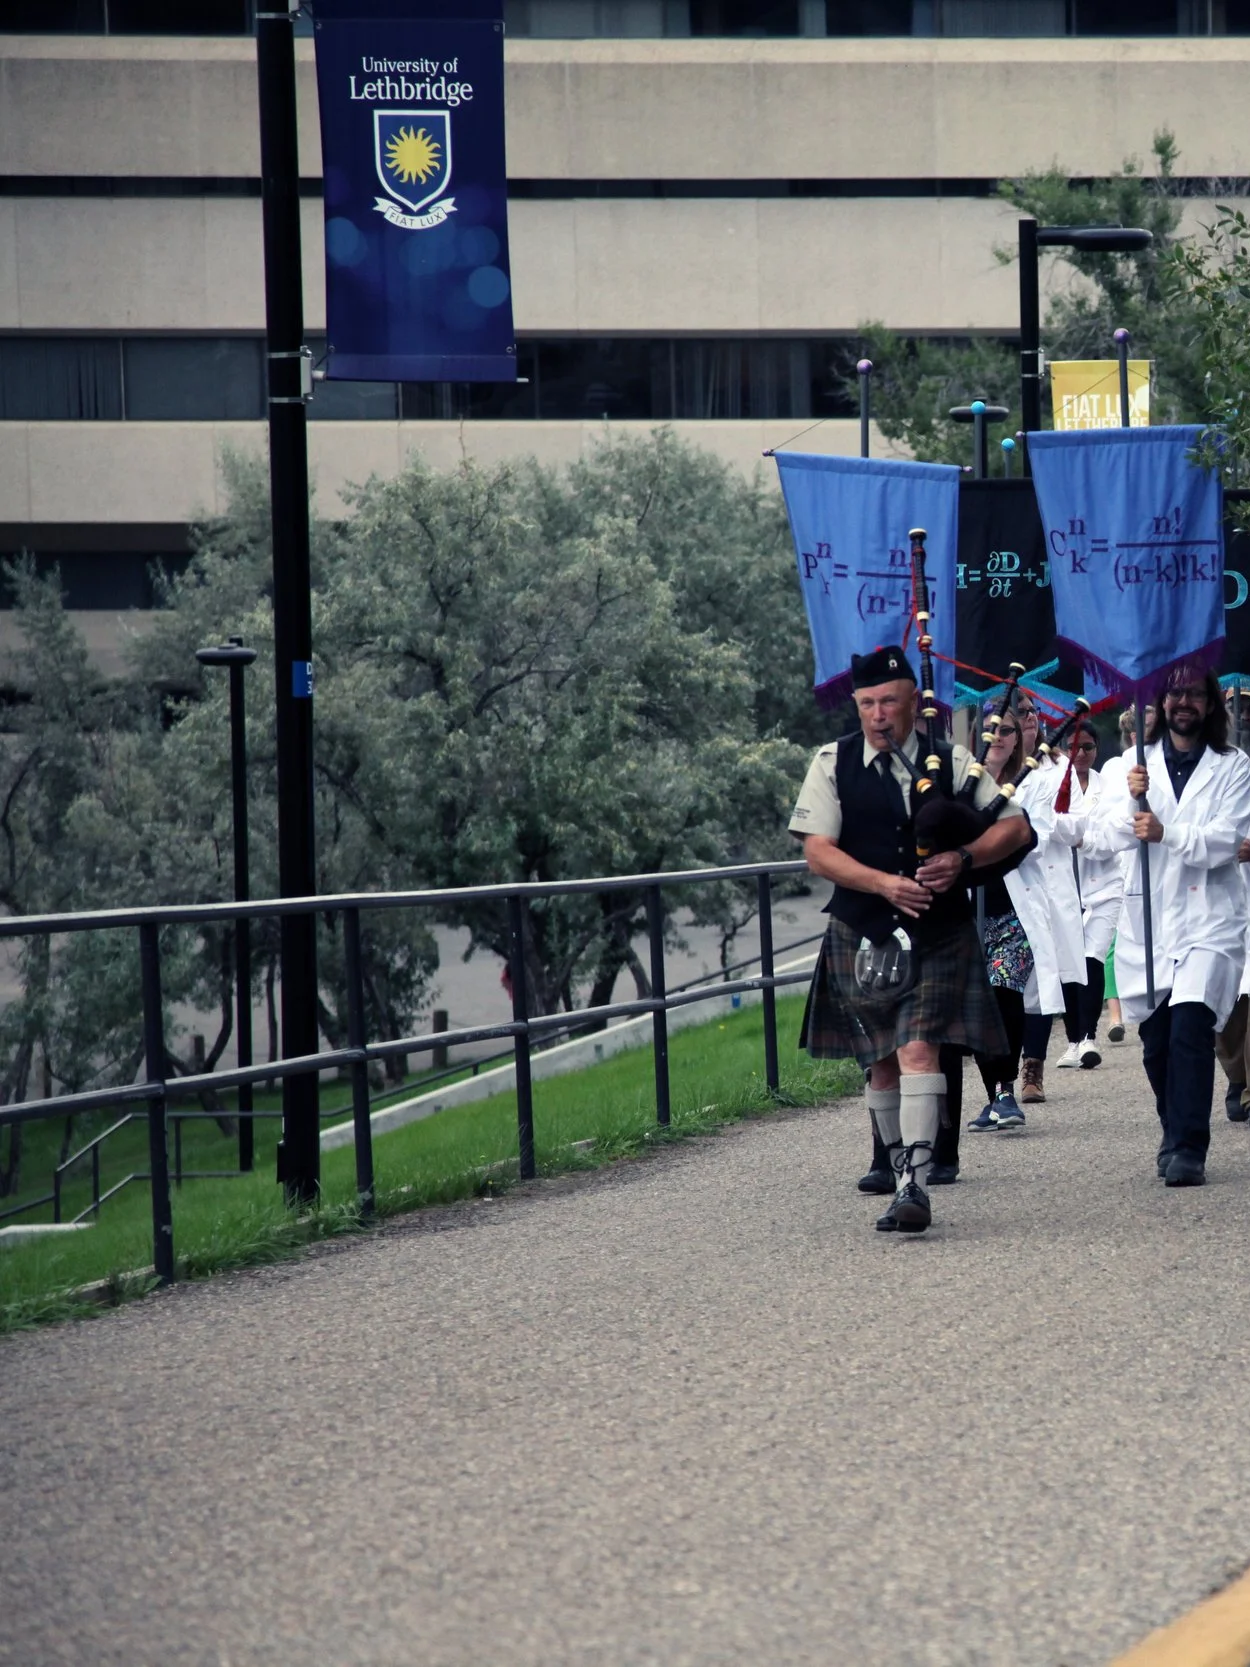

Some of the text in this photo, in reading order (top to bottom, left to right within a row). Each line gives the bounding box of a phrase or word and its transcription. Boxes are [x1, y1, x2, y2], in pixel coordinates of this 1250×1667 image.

[362, 56, 458, 76] University of
[349, 75, 474, 107] Lethbridge
[389, 212, 443, 227] FIAT LUX
[1062, 394, 1101, 418] FIAT
[1084, 418, 1121, 430] THER
